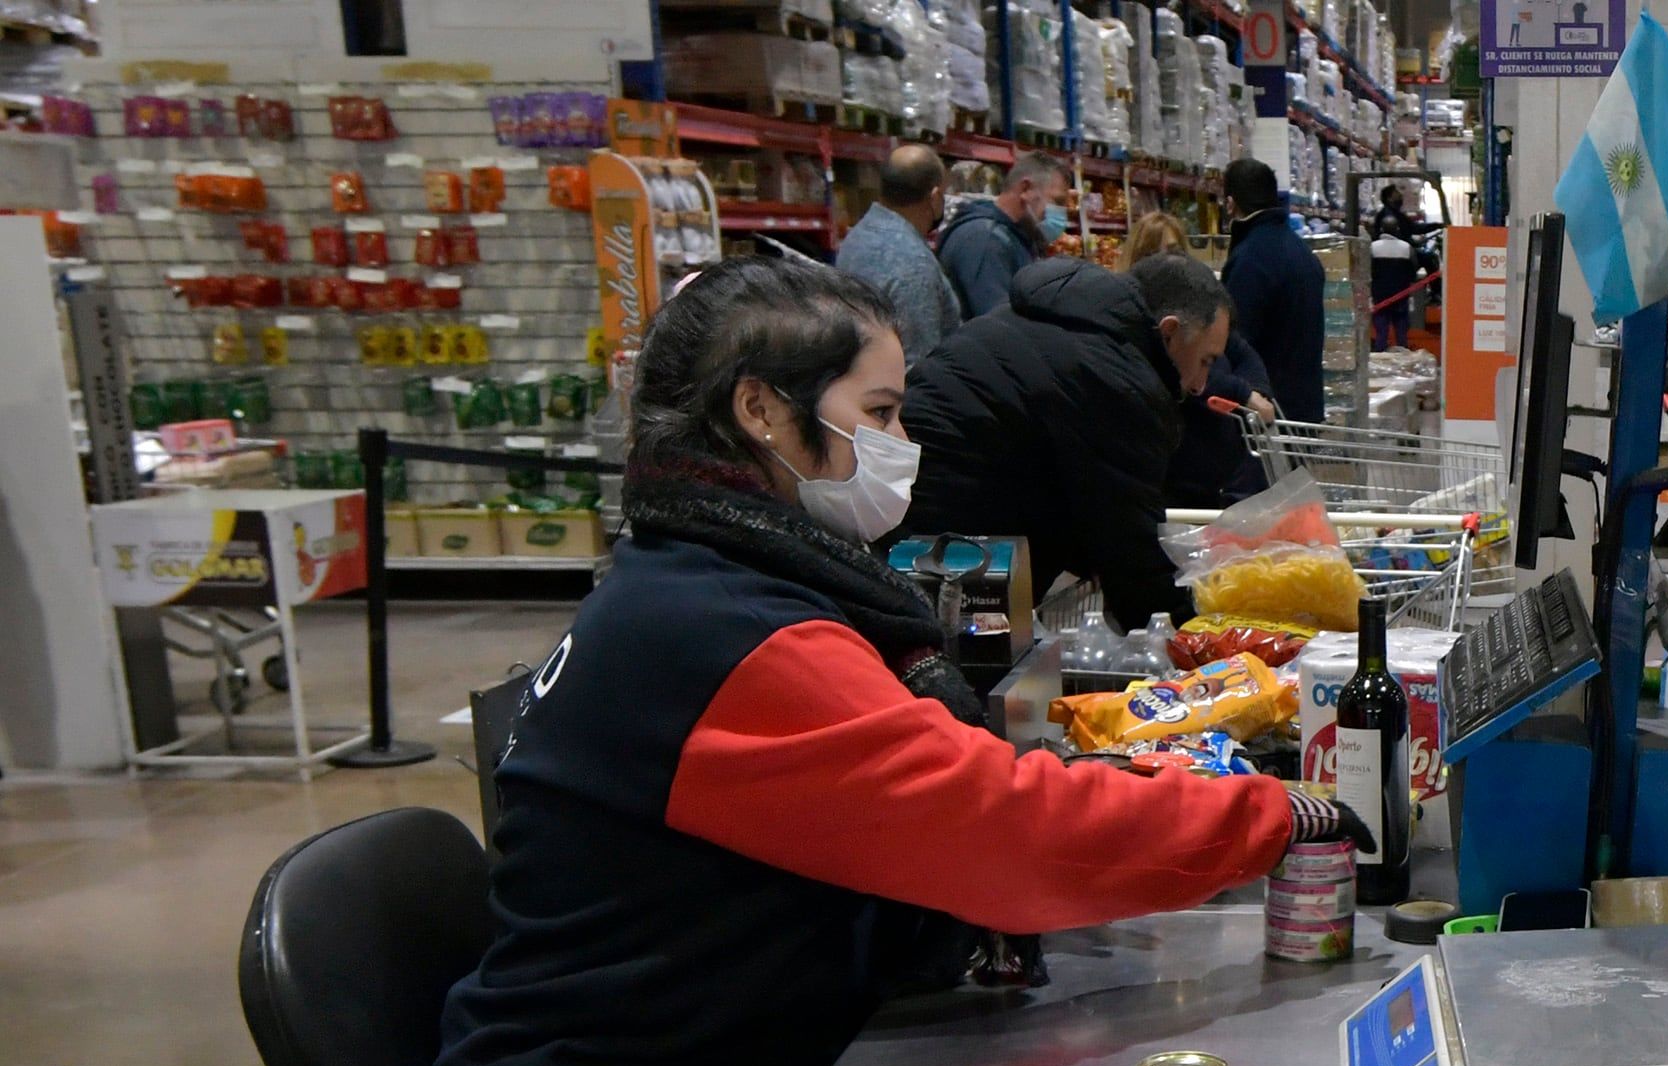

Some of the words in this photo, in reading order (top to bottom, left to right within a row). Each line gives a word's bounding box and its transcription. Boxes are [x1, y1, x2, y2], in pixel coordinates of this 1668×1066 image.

[1500, 51, 1531, 61] CLIENTE
[1534, 51, 1544, 61] SE
[1547, 51, 1572, 61] RUEGA
[1574, 51, 1619, 61] MANTENER
[1498, 64, 1572, 74] DISTANCIAMIENTO
[1574, 64, 1602, 74] SOCIAL
